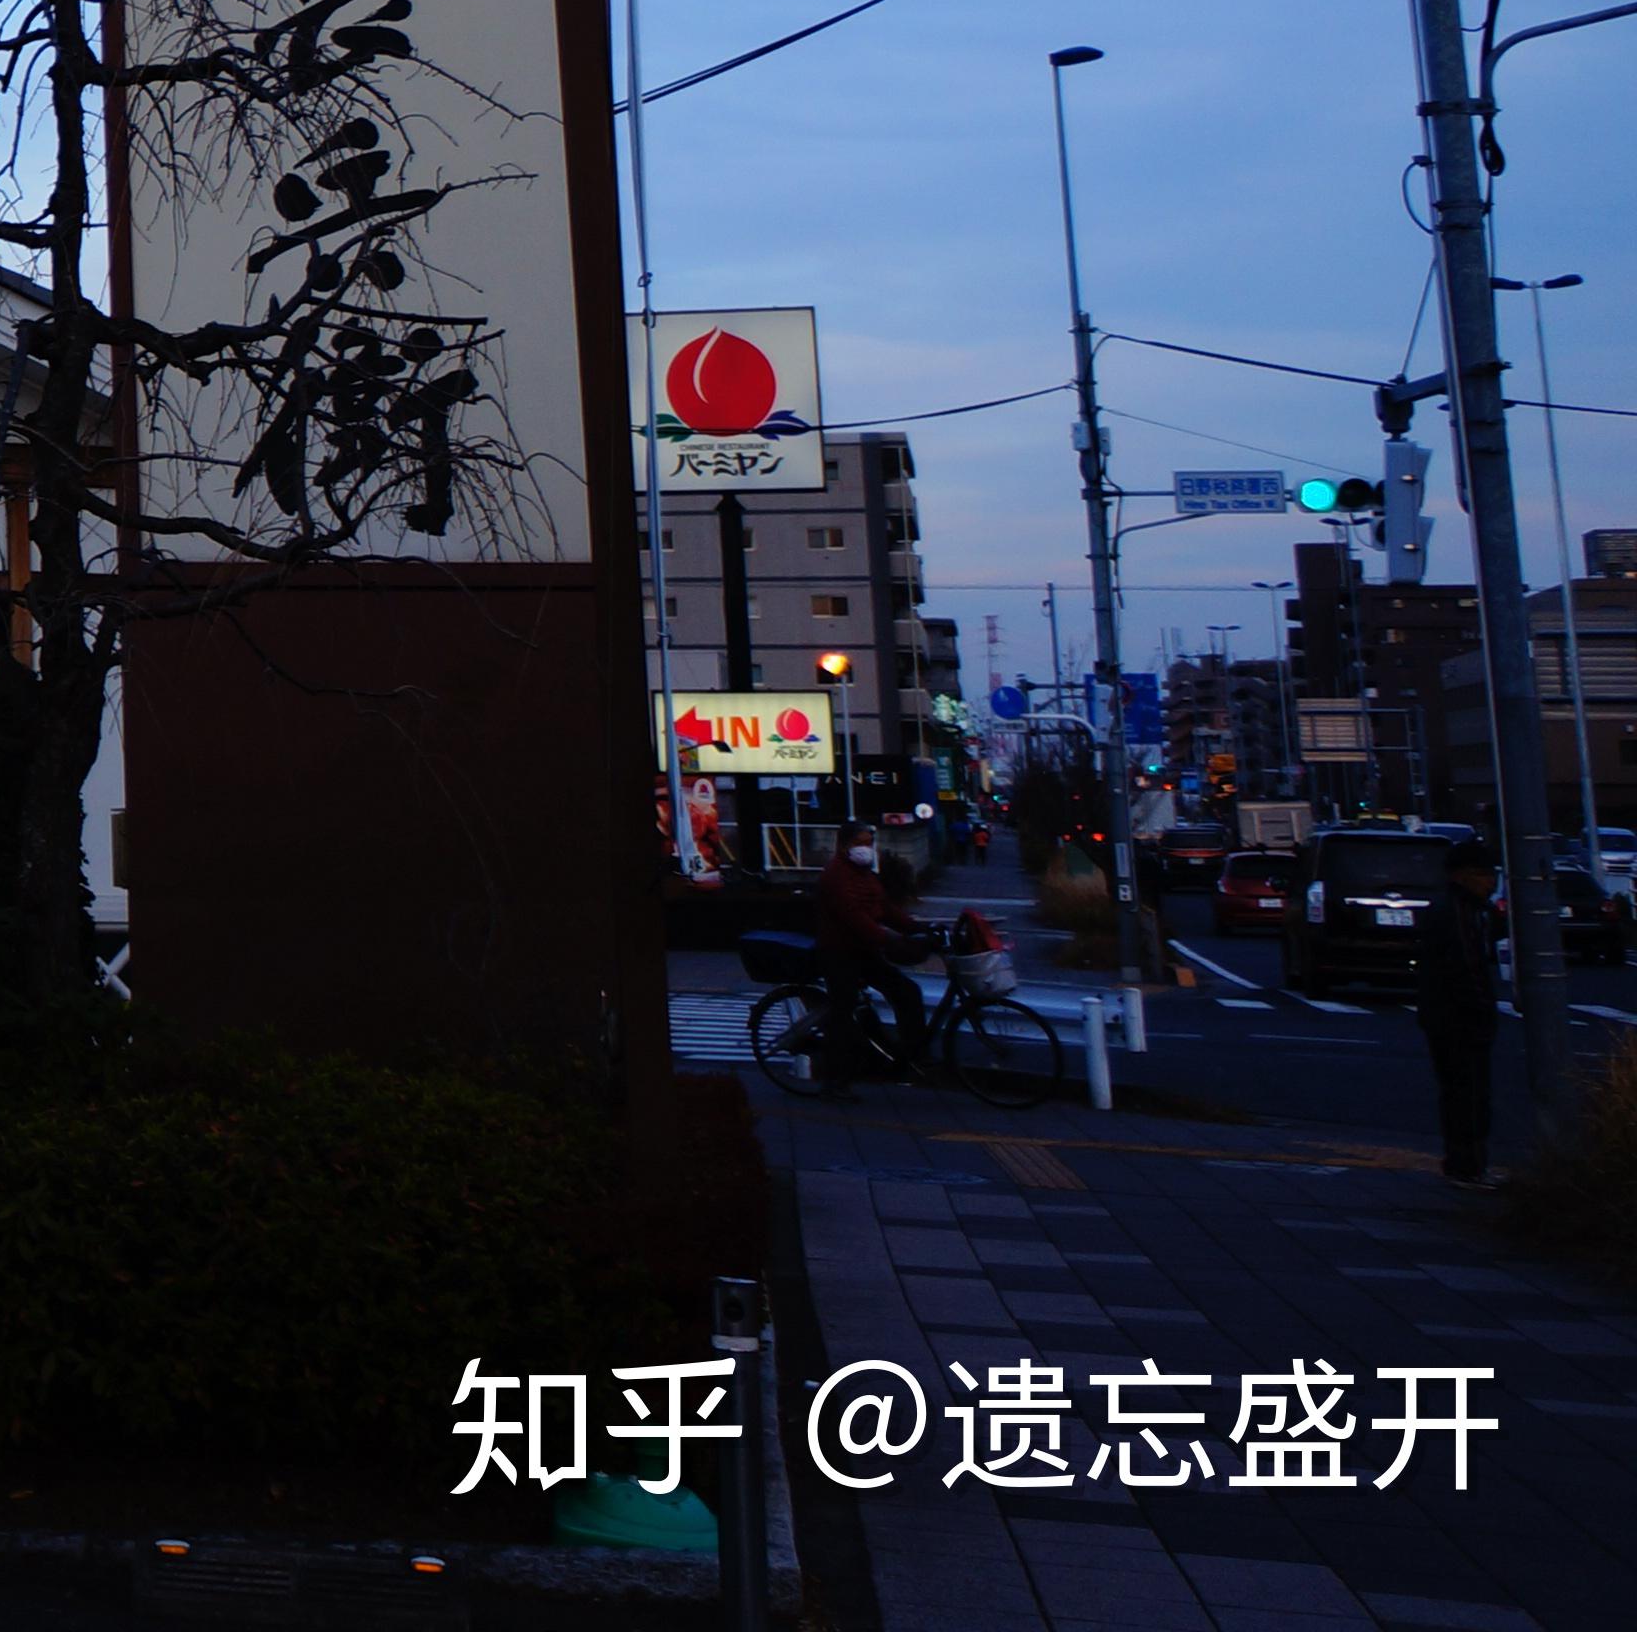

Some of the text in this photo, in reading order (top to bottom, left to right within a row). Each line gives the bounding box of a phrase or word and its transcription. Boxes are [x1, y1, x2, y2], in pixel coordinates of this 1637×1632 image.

[670, 452, 784, 476] バーミヤン
[717, 717, 761, 748] IN
